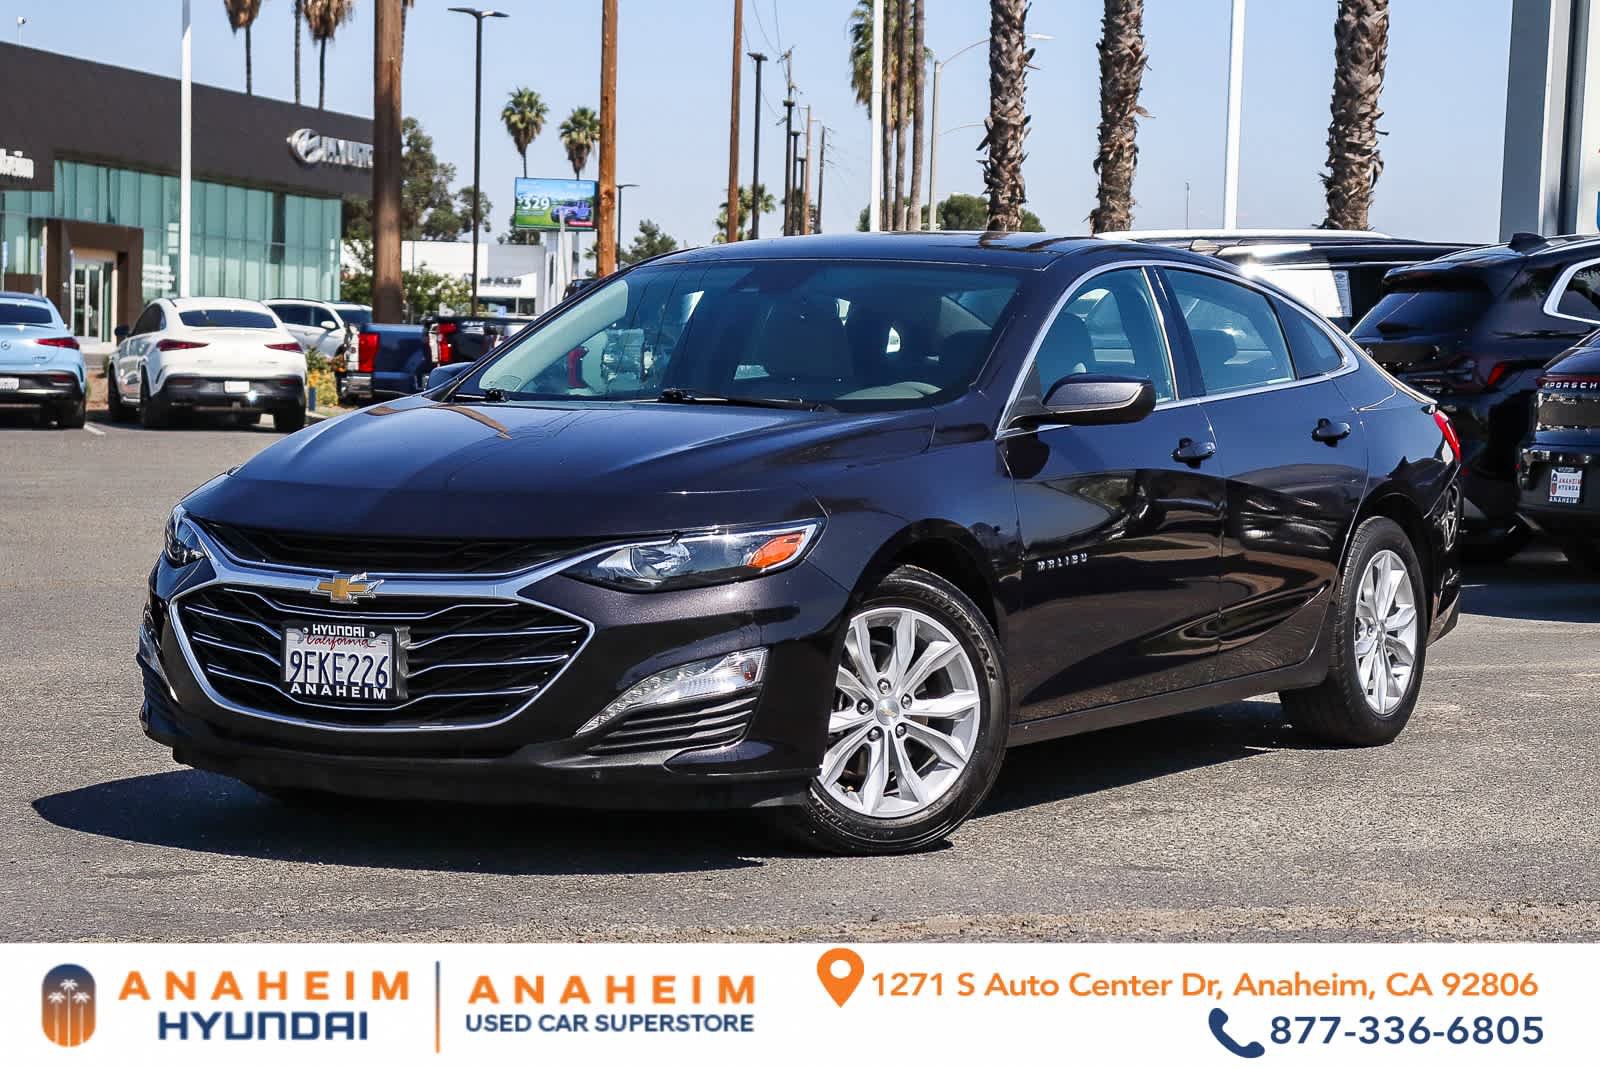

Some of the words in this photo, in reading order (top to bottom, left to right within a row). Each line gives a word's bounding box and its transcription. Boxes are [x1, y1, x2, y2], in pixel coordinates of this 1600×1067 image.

[312, 624, 365, 637] HYUNDAI
[306, 634, 376, 650] California
[290, 650, 388, 689] 9FKE226
[290, 682, 387, 700] ANAHEIM
